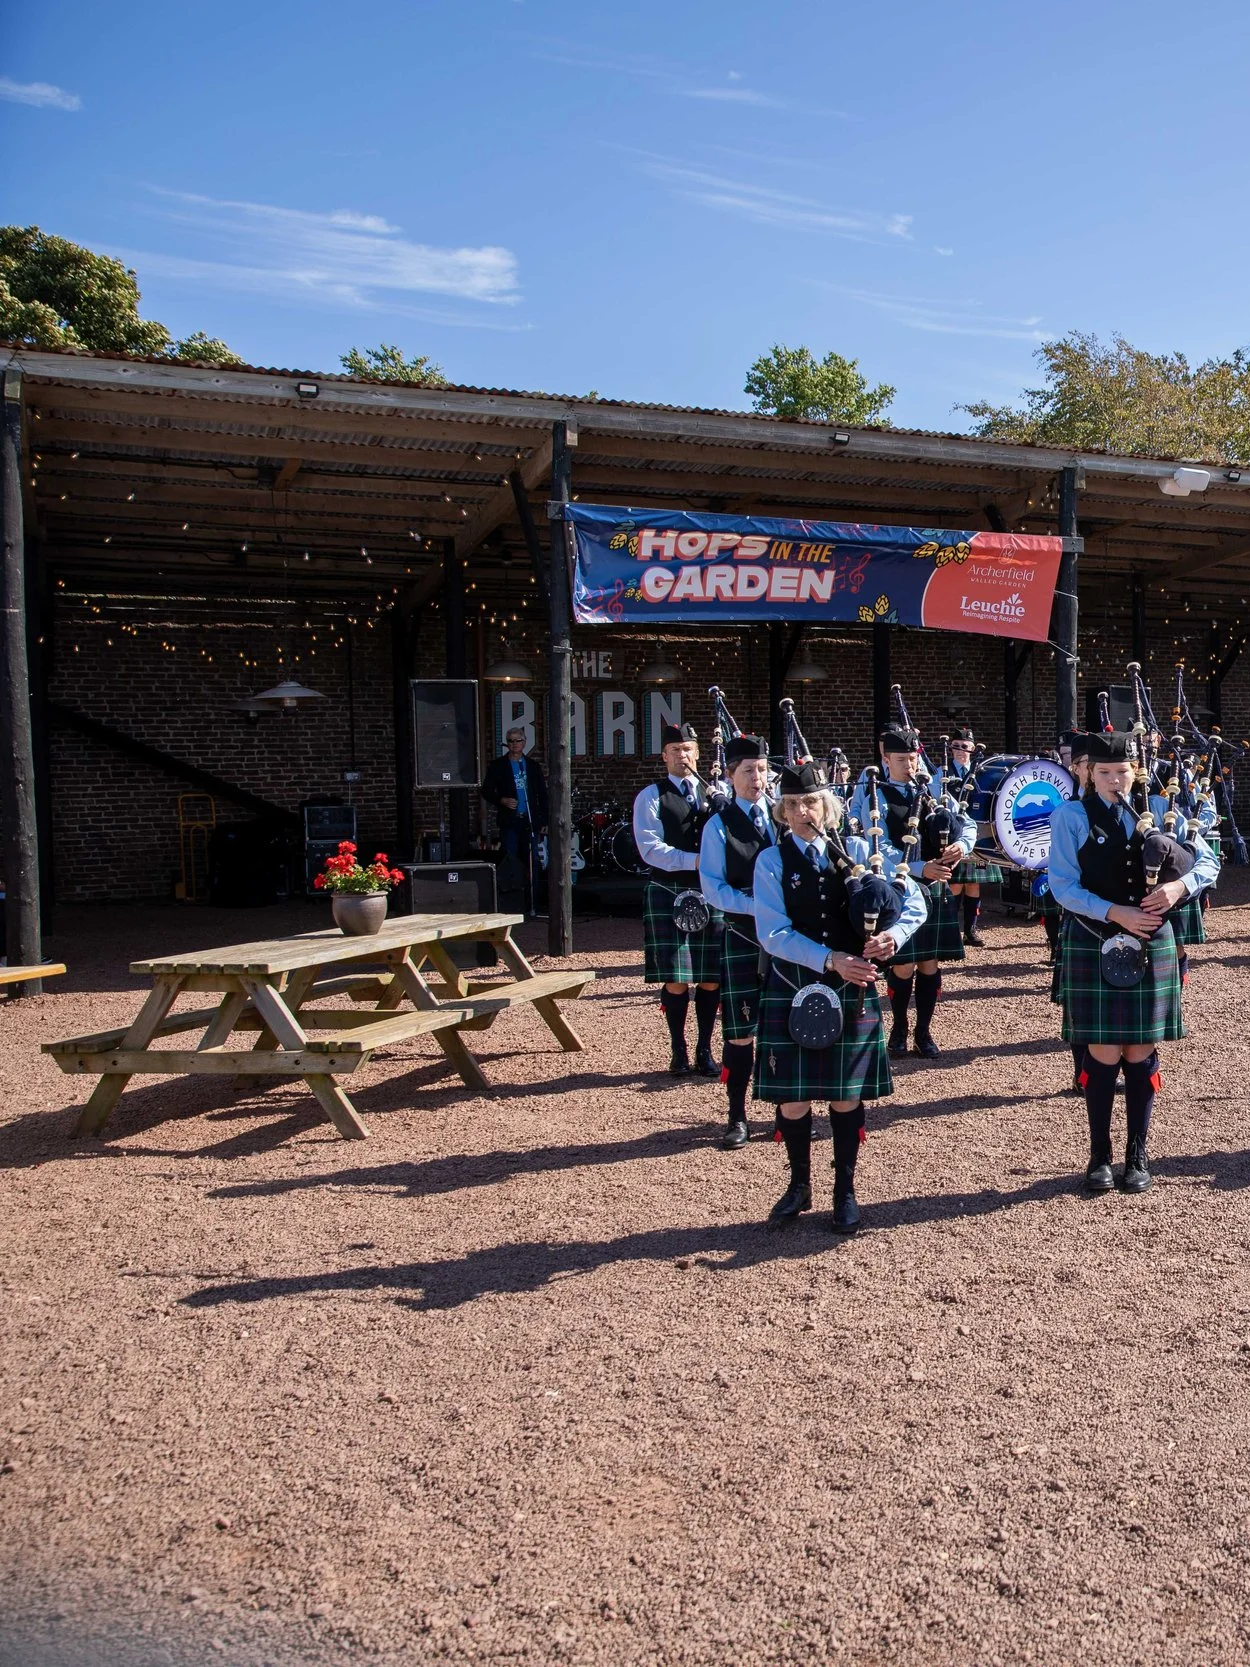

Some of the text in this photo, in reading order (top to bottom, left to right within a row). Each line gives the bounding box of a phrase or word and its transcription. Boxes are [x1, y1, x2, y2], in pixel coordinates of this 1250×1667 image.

[638, 529, 836, 563] HOPS IN THE
[641, 565, 837, 603] GARDEN
[967, 564, 1035, 582] Archerfield
[970, 577, 997, 585] WALLED
[960, 593, 1026, 617] Leuchie
[962, 610, 1021, 624] Reimagining Respite
[572, 651, 613, 679] THE
[1032, 770, 1072, 801] BERWIC
[1003, 776, 1028, 822] NORTH
[1012, 839, 1035, 858] PIPE
